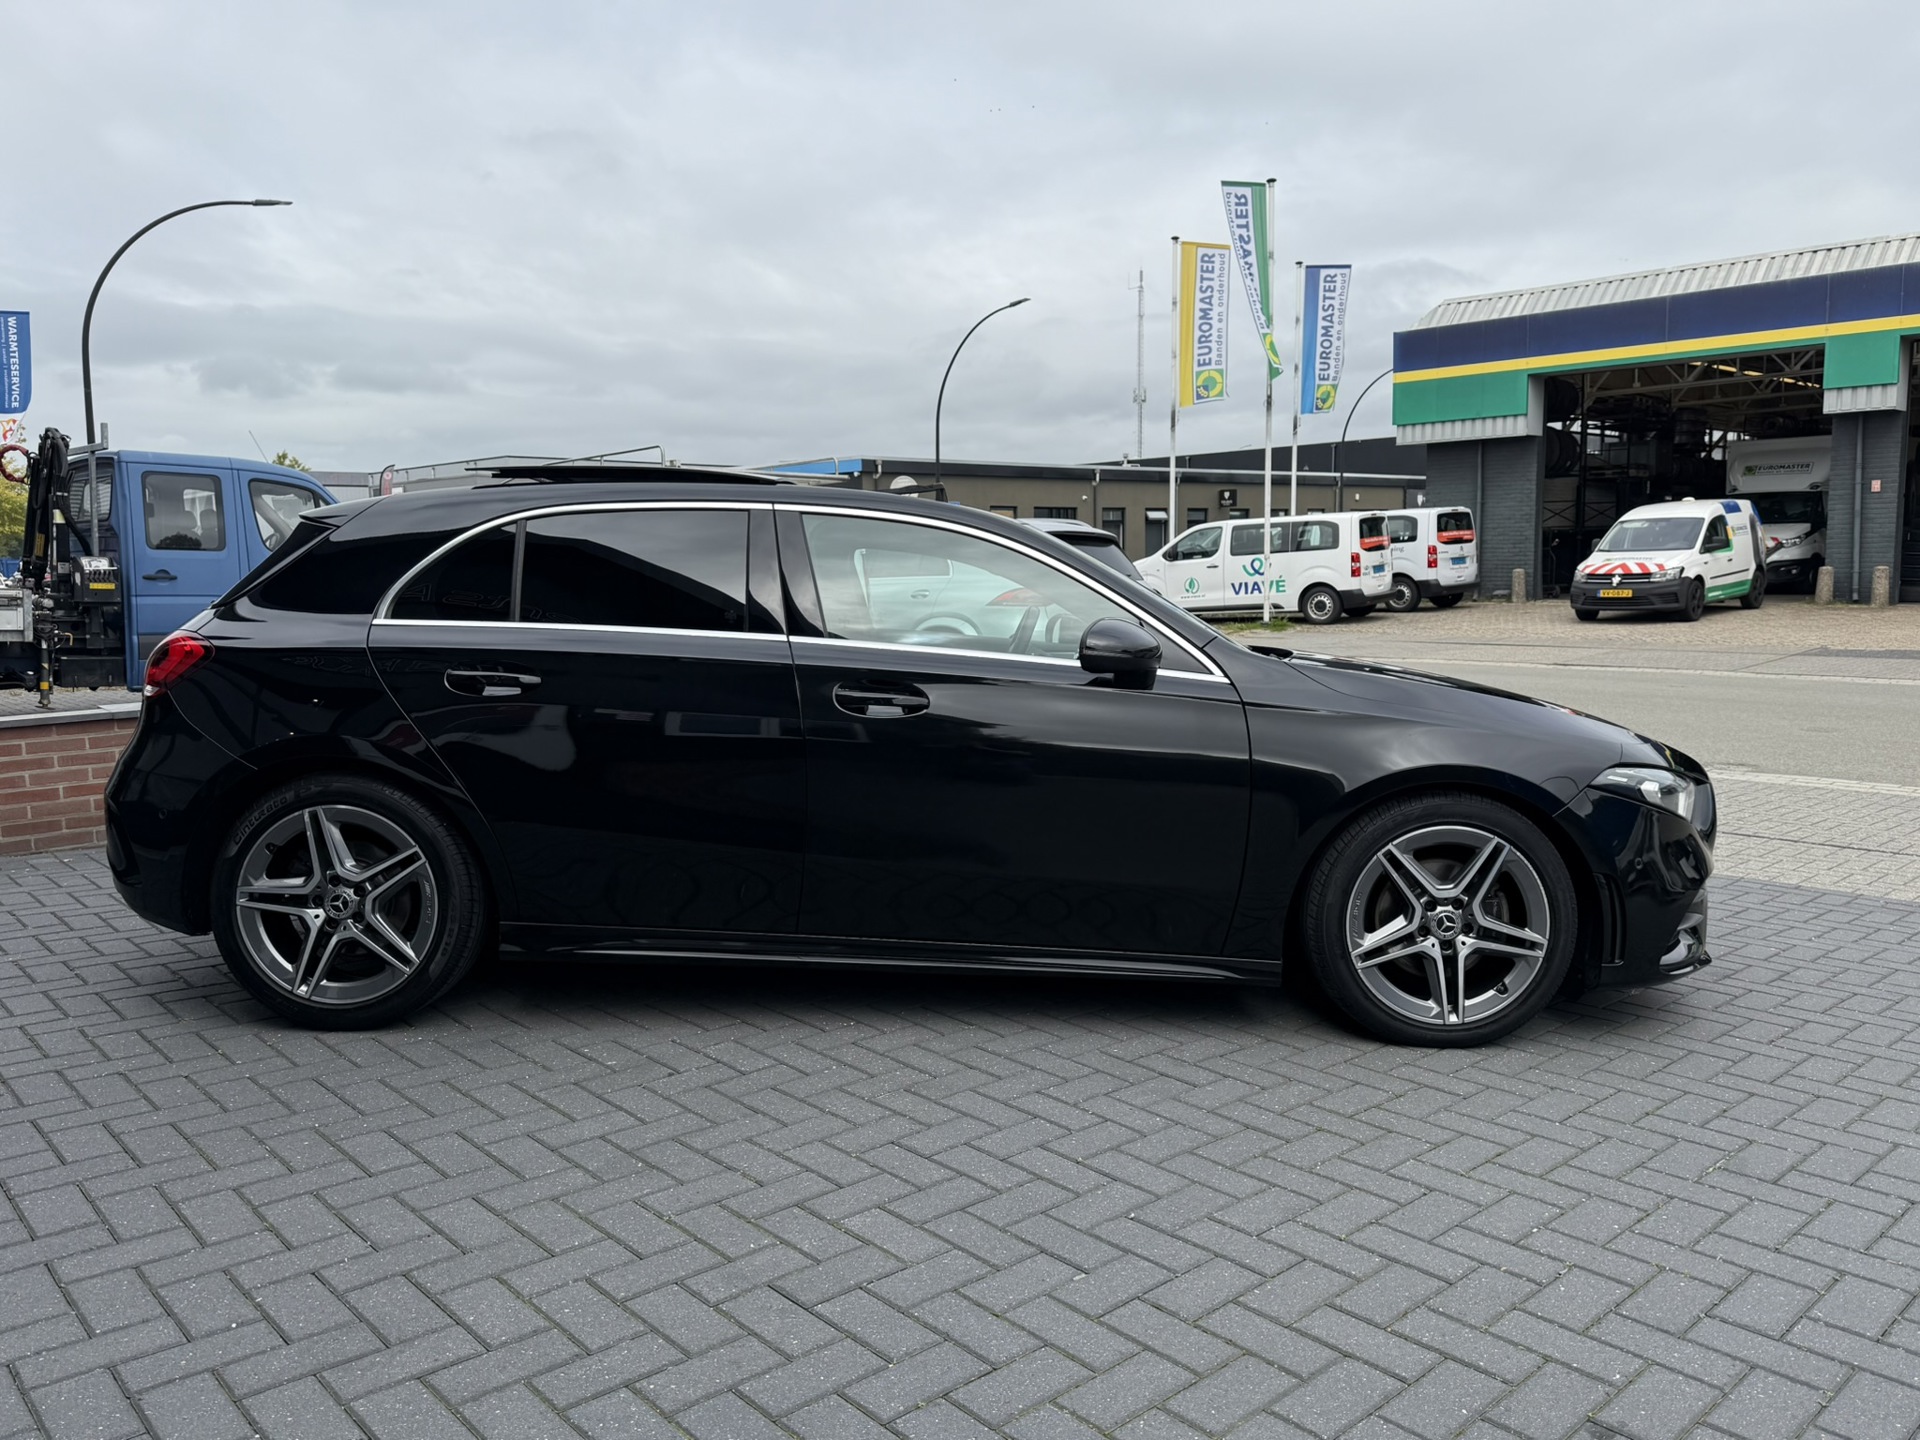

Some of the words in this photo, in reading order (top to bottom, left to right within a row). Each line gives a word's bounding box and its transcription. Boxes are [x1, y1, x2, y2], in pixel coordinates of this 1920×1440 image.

[1217, 253, 1226, 308] onderhoud
[1337, 272, 1347, 326] onderhoud
[1197, 253, 1216, 368] EUROMASTER
[1217, 311, 1224, 323] en
[1318, 273, 1338, 382] EUROMASTER
[1214, 327, 1224, 366] Banden
[1336, 329, 1342, 341] en
[7, 316, 19, 408] WARMTESERVICE
[1332, 345, 1341, 381] Banden
[1758, 463, 1811, 471] EUROMASTER
